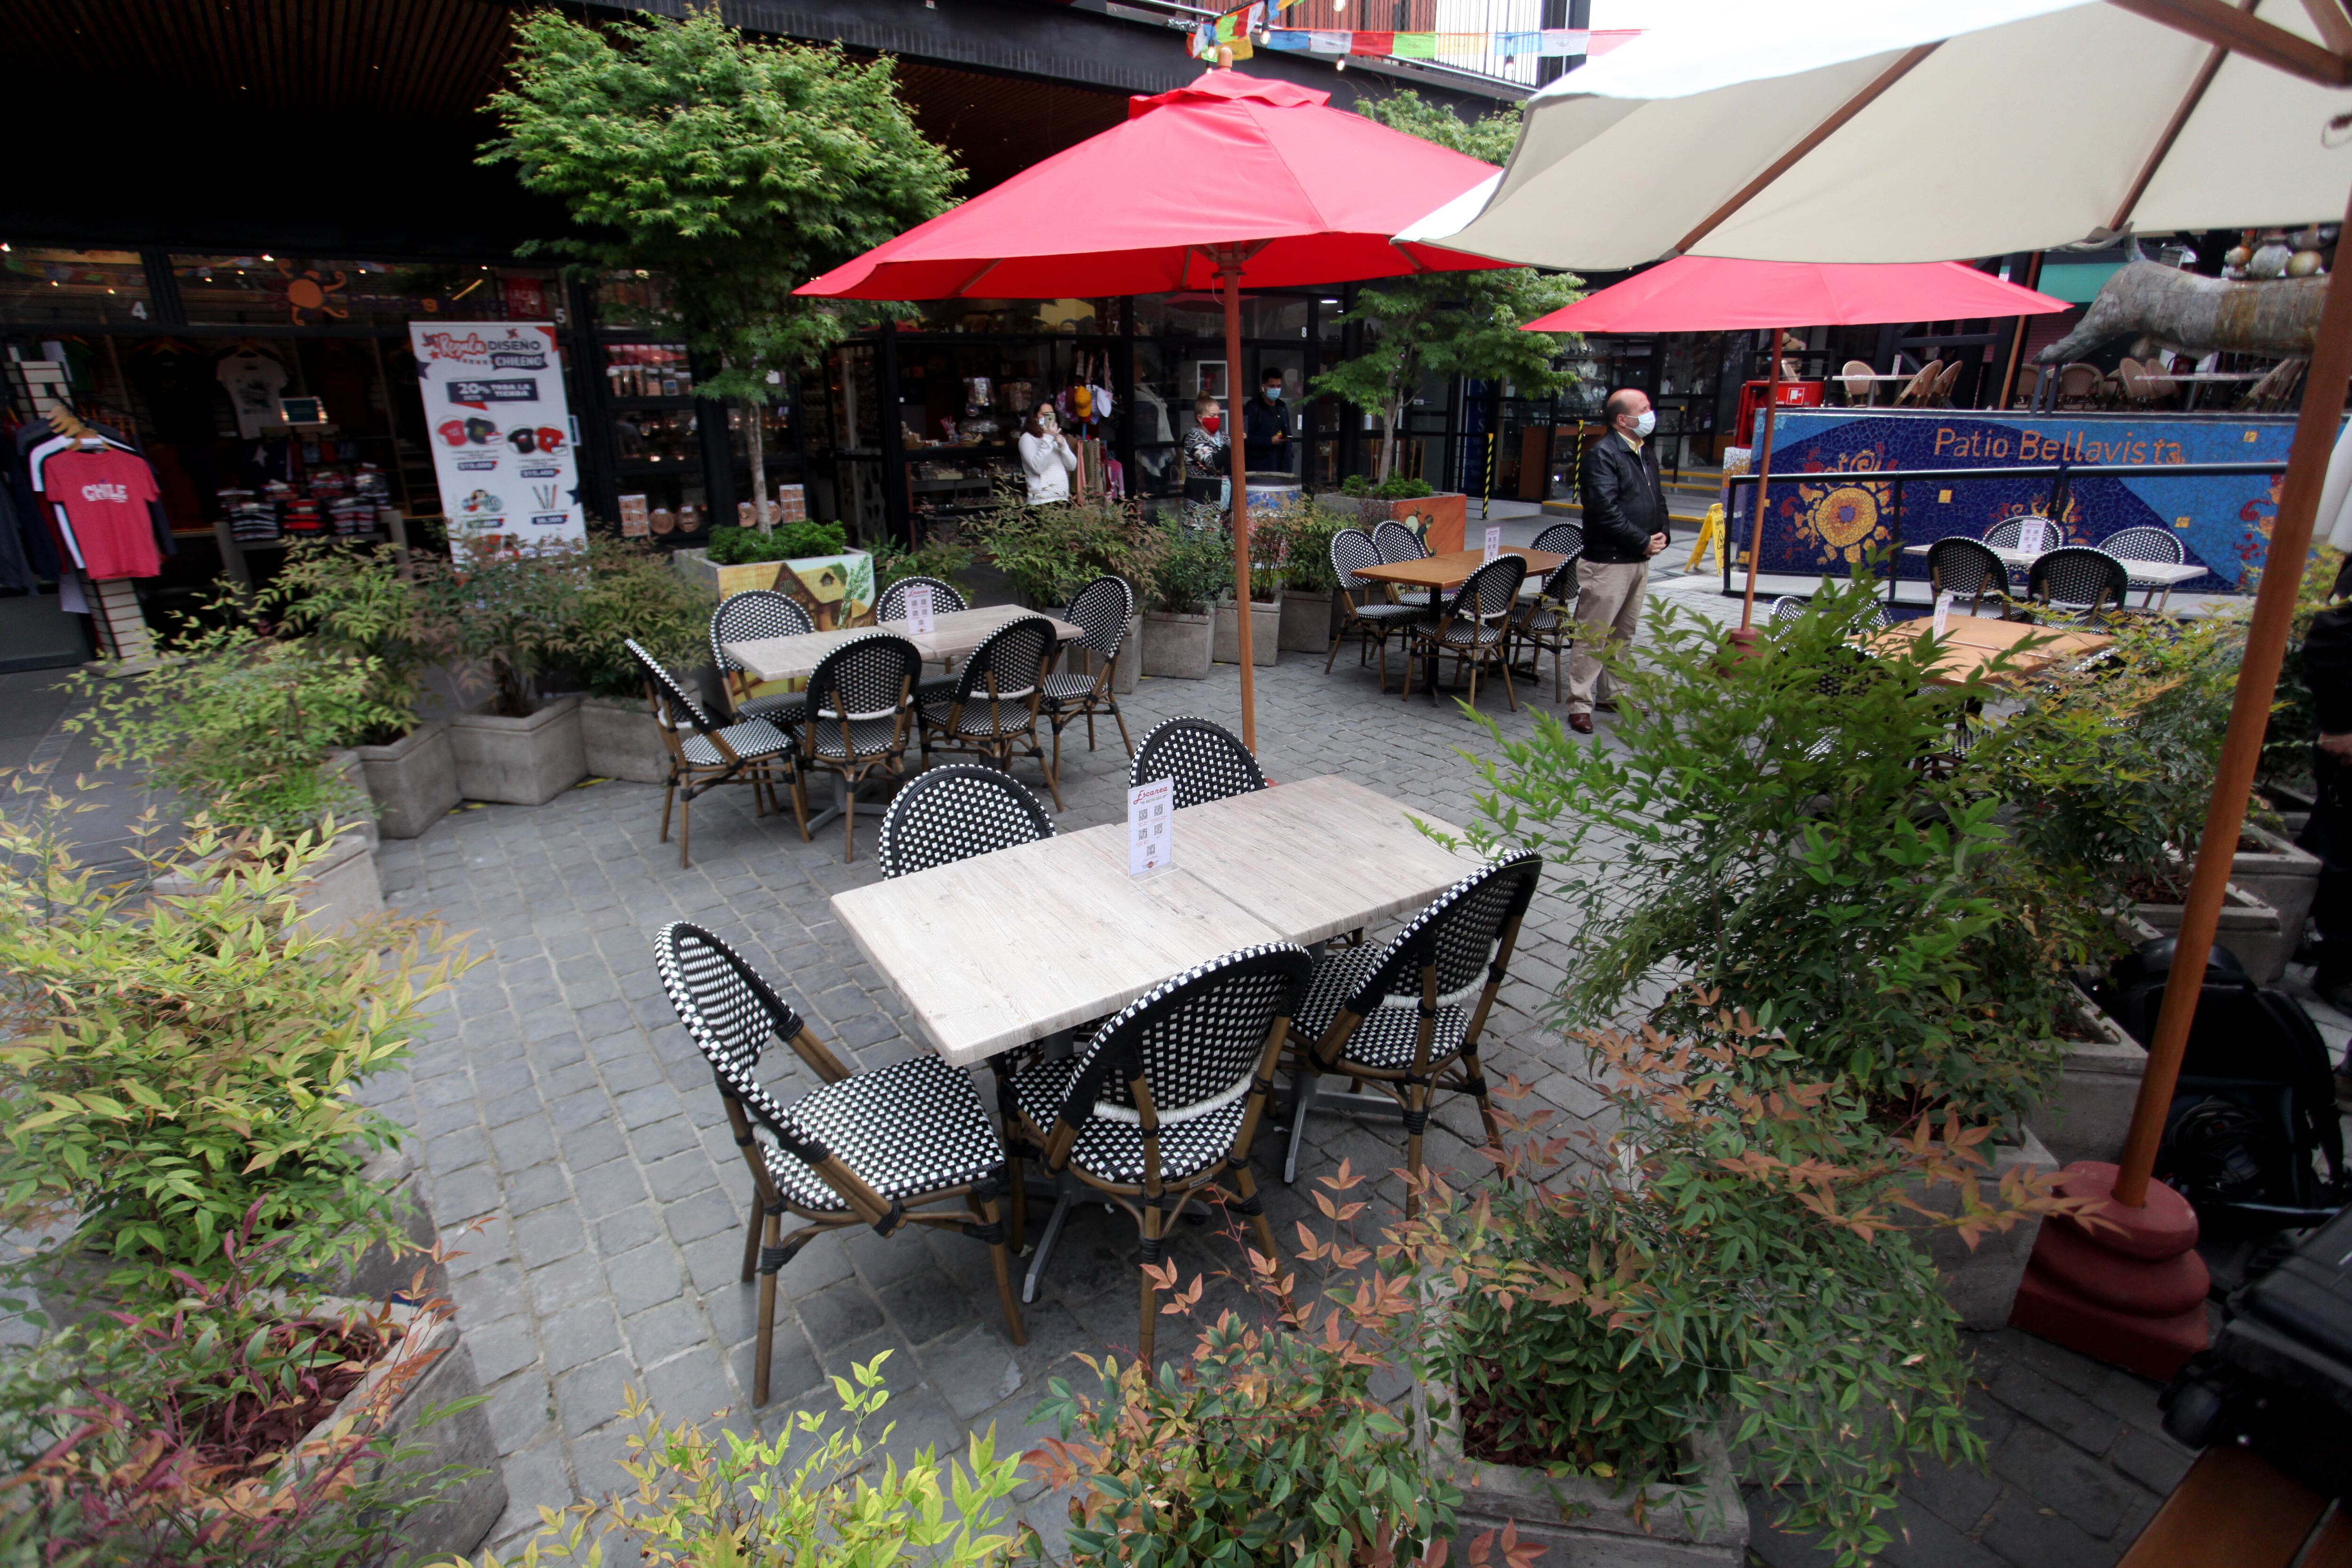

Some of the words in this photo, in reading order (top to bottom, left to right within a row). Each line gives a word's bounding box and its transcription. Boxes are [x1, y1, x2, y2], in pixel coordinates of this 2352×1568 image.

[131, 301, 148, 320] 4
[555, 308, 566, 324] 5
[1112, 321, 1119, 332] 7
[1302, 327, 1307, 337] 8
[488, 338, 540, 350] DISEÑO
[495, 356, 541, 366] CHILENO
[458, 382, 491, 395] 20%
[1934, 427, 2009, 458] Patio
[2018, 430, 2183, 465] Bellavista
[81, 484, 128, 501] CHILE
[1133, 787, 1168, 804] Escanea
